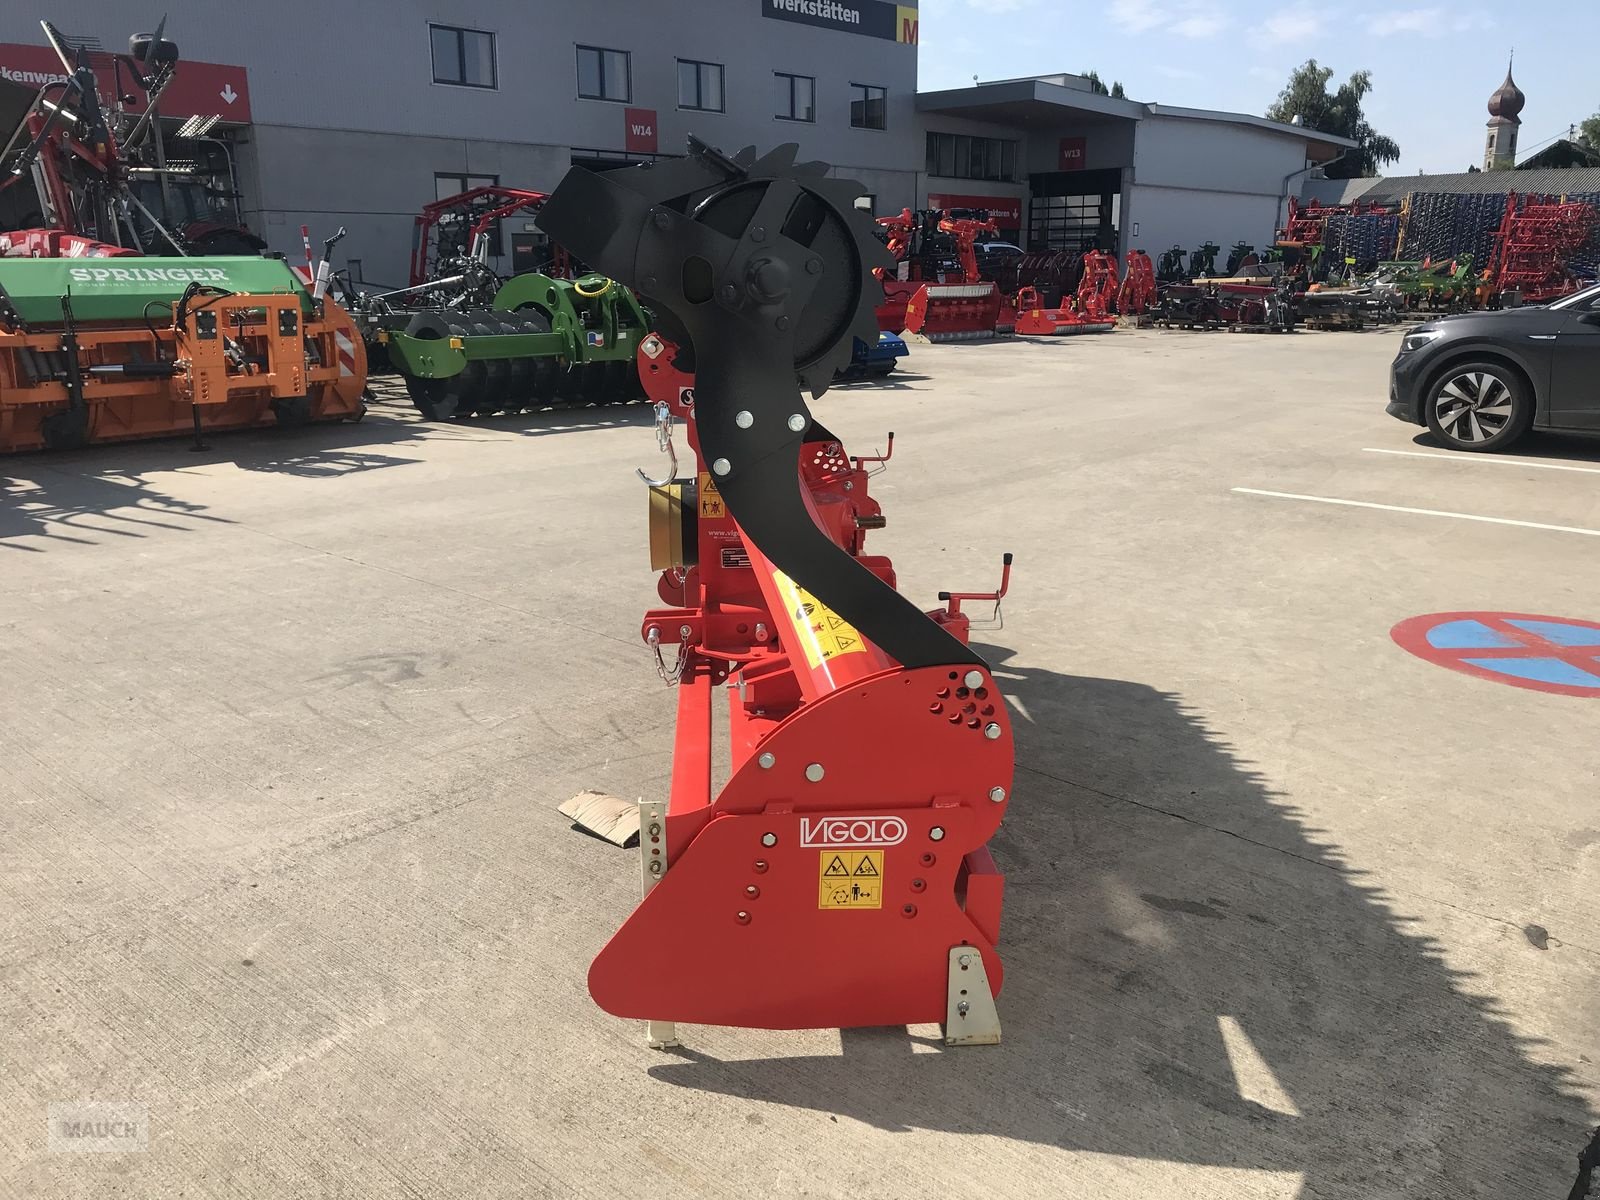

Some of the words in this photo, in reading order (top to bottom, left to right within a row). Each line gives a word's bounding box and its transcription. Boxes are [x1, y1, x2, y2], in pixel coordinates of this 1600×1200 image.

[631, 124, 652, 137] W14
[1064, 149, 1081, 158] W13
[69, 268, 229, 281] SPRINGER
[800, 816, 908, 848] VIGOLO
